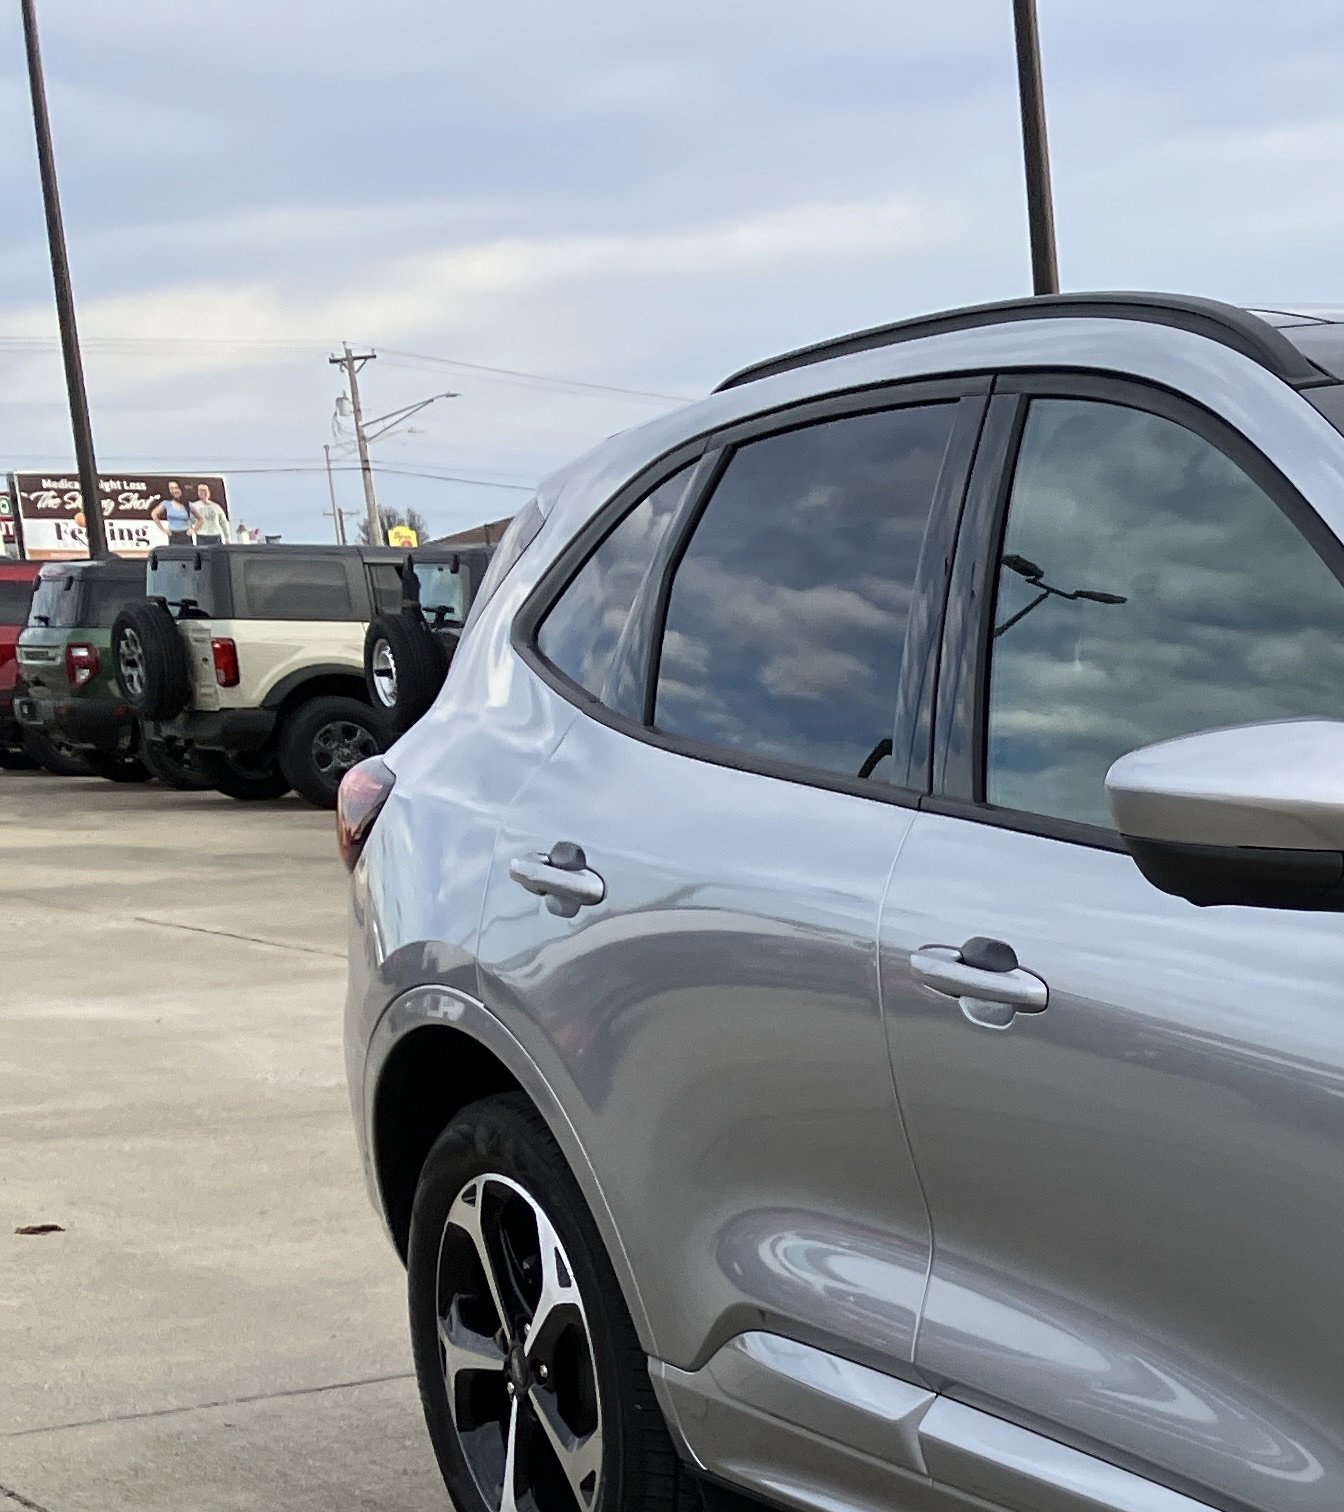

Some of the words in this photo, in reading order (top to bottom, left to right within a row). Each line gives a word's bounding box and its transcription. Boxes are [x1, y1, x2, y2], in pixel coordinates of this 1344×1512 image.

[41, 478, 81, 489] Medica
[123, 480, 146, 490] Loss
[54, 521, 150, 547] Feing
